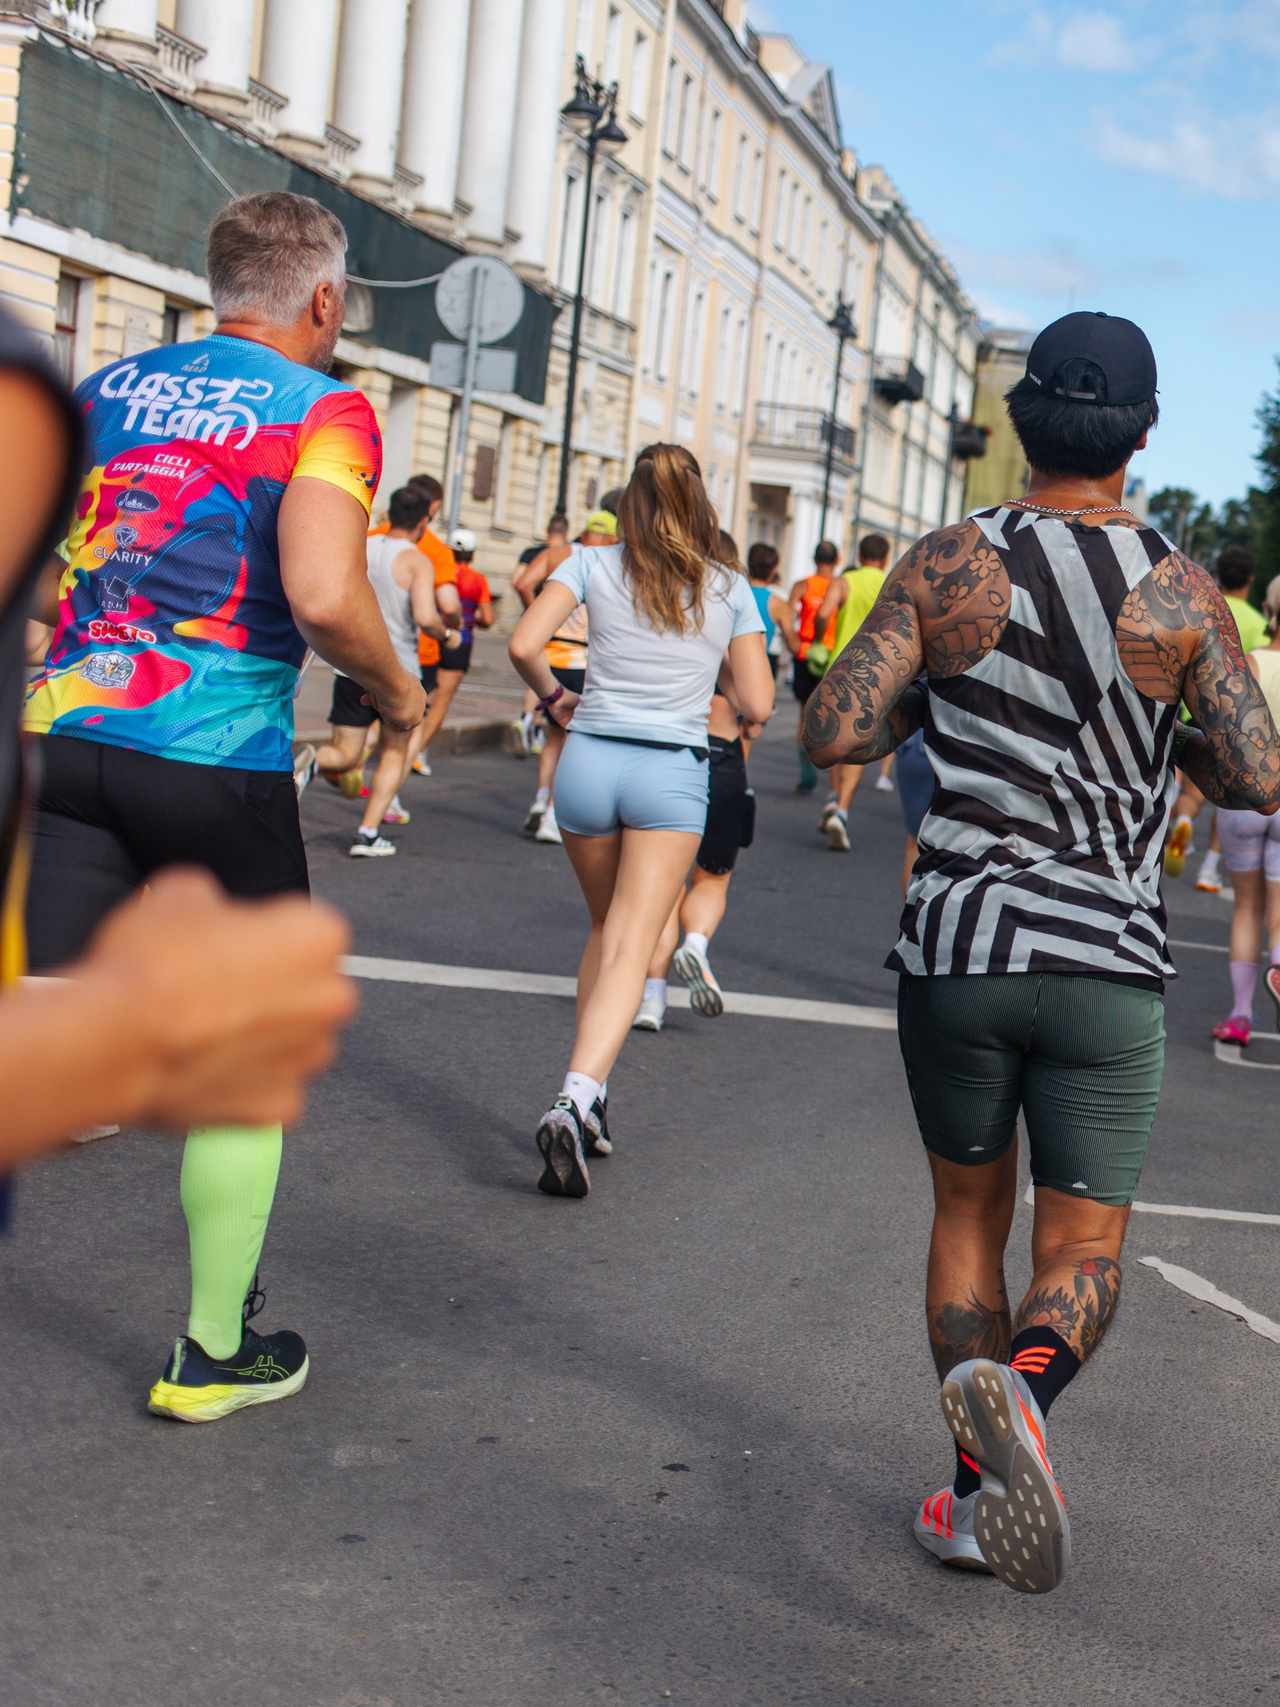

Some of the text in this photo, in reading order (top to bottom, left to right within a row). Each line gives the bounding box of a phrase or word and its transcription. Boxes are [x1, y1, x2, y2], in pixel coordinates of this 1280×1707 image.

[122, 397, 258, 450] TEAM
[154, 453, 192, 468] CICLI
[111, 462, 185, 479] TARTAGGIA
[94, 546, 153, 566] CLARITY
